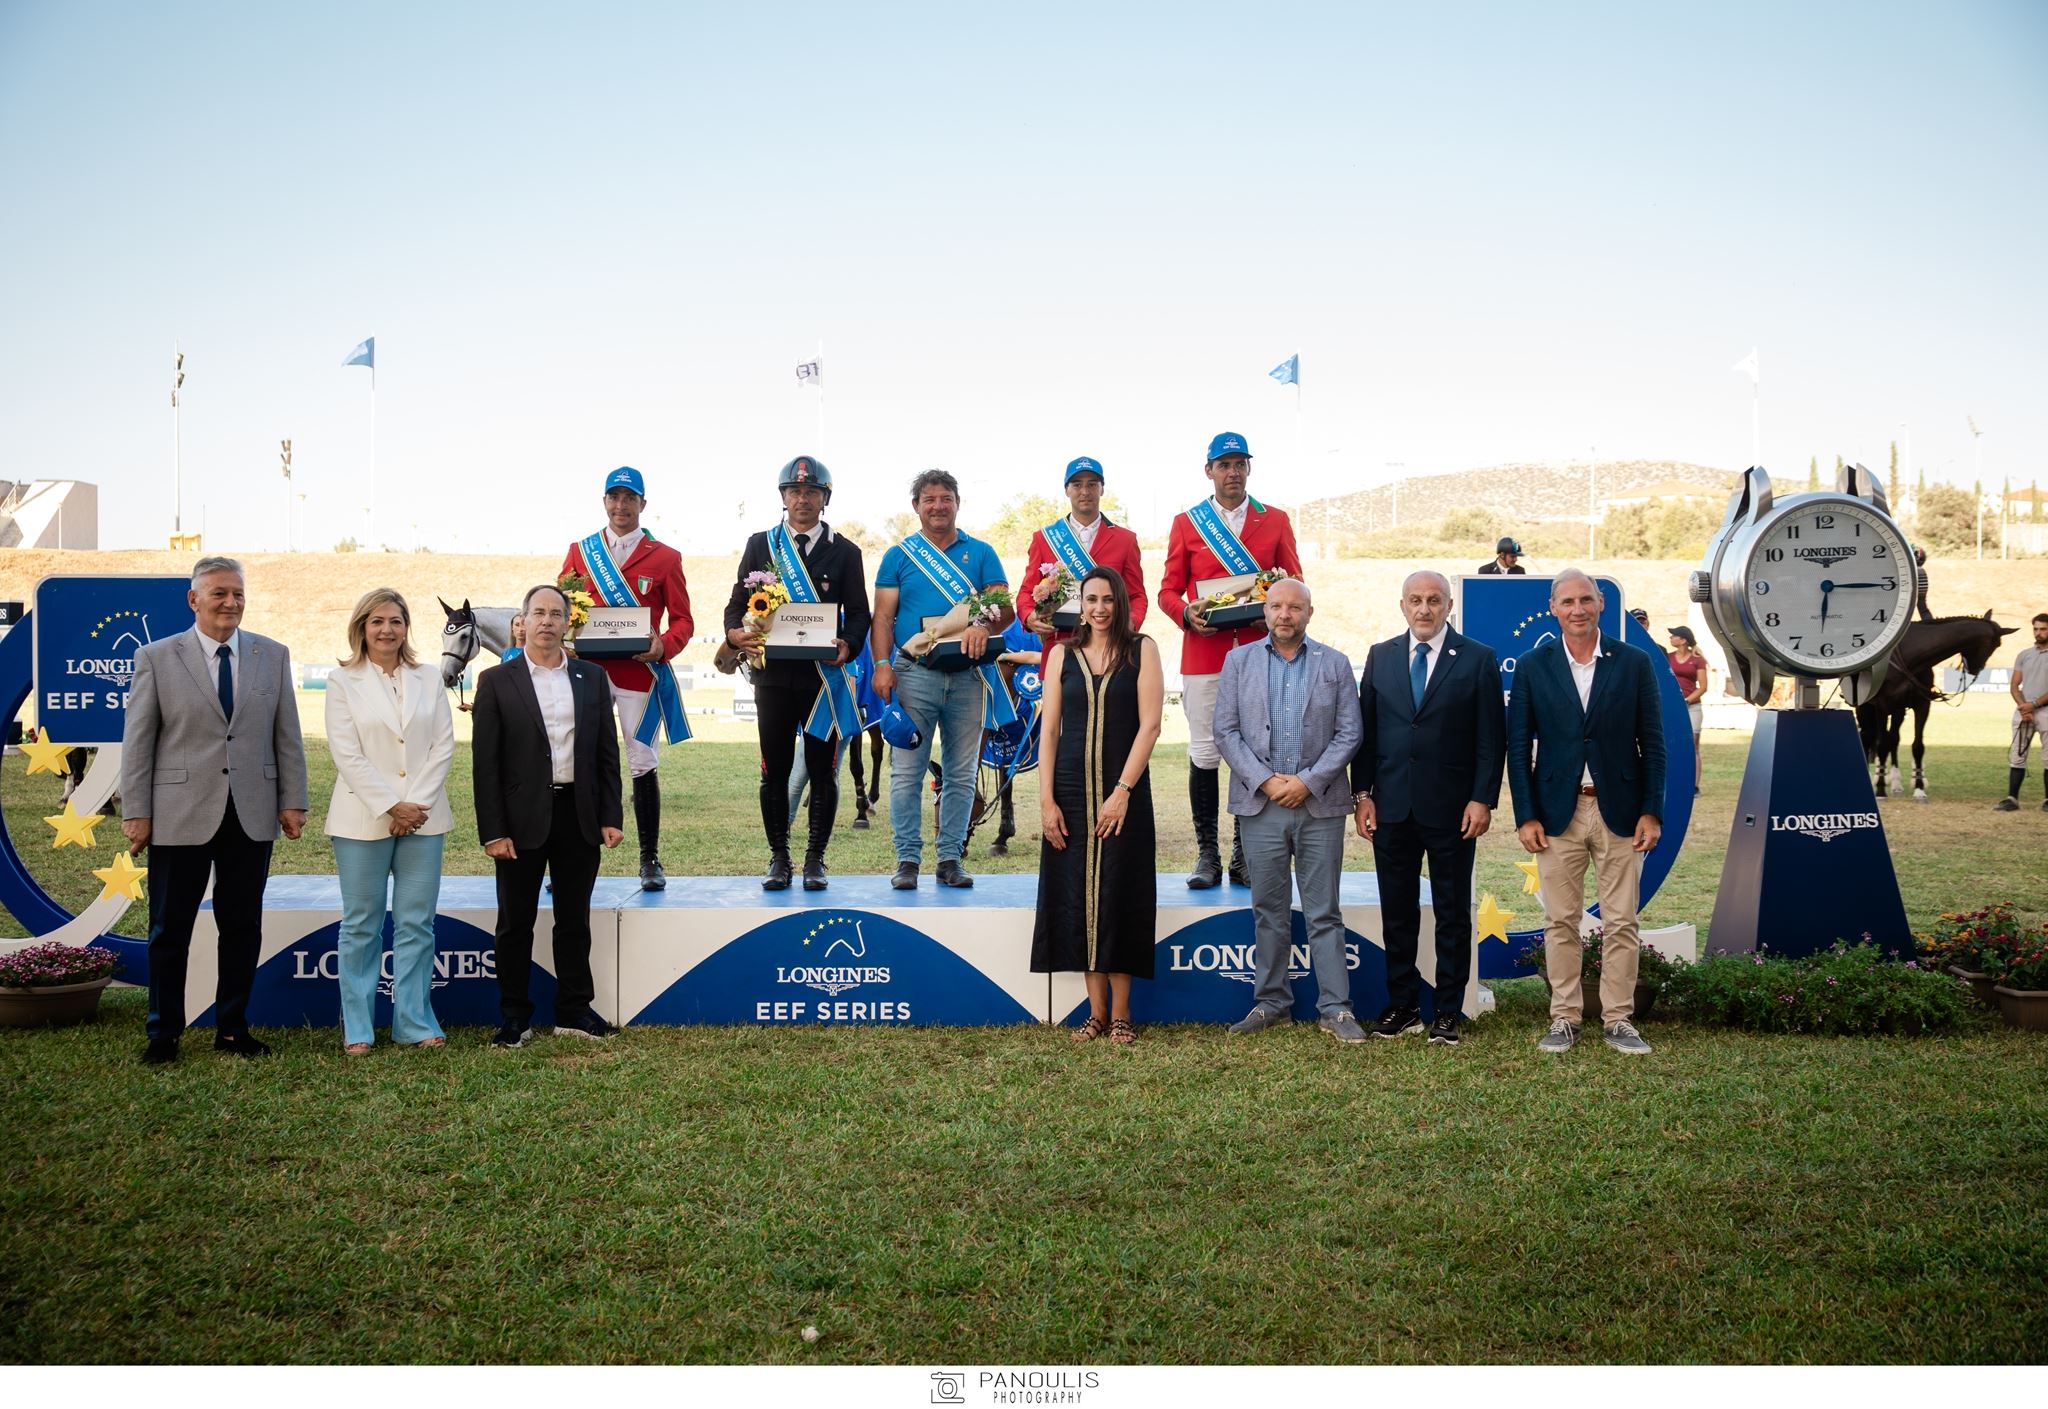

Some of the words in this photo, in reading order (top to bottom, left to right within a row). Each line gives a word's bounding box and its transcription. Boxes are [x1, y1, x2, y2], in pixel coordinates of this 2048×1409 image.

[1815, 515, 1834, 529] 12
[1787, 525, 1799, 539] 11
[1854, 524, 1860, 537] 1
[1205, 519, 1236, 557] LONGINES
[1234, 557, 1248, 572] EEF
[1794, 546, 1857, 558] LONGINES
[1873, 545, 1886, 558] 2
[1063, 544, 1089, 577] LONGIN
[1765, 548, 1784, 562] 10
[592, 550, 617, 592] LONGINES
[779, 539, 797, 579] ONGINES
[793, 580, 805, 596] EEF
[949, 580, 965, 595] EEF
[1755, 581, 1770, 595] 9
[1881, 576, 1896, 591] 3
[781, 615, 824, 623] LONGINES
[1765, 612, 1780, 627] 8
[1871, 609, 1887, 623] 4
[1789, 636, 1803, 650] 7
[1852, 633, 1865, 648] 5
[1820, 643, 1834, 658] 6
[66, 659, 135, 675] LONGI
[47, 692, 96, 710] EEF
[1771, 812, 1879, 831] LONGINES
[1170, 944, 1361, 971] LONNS
[777, 967, 890, 983] LONGINES
[756, 1002, 806, 1020] EEF
[817, 1002, 911, 1020] SERIES
